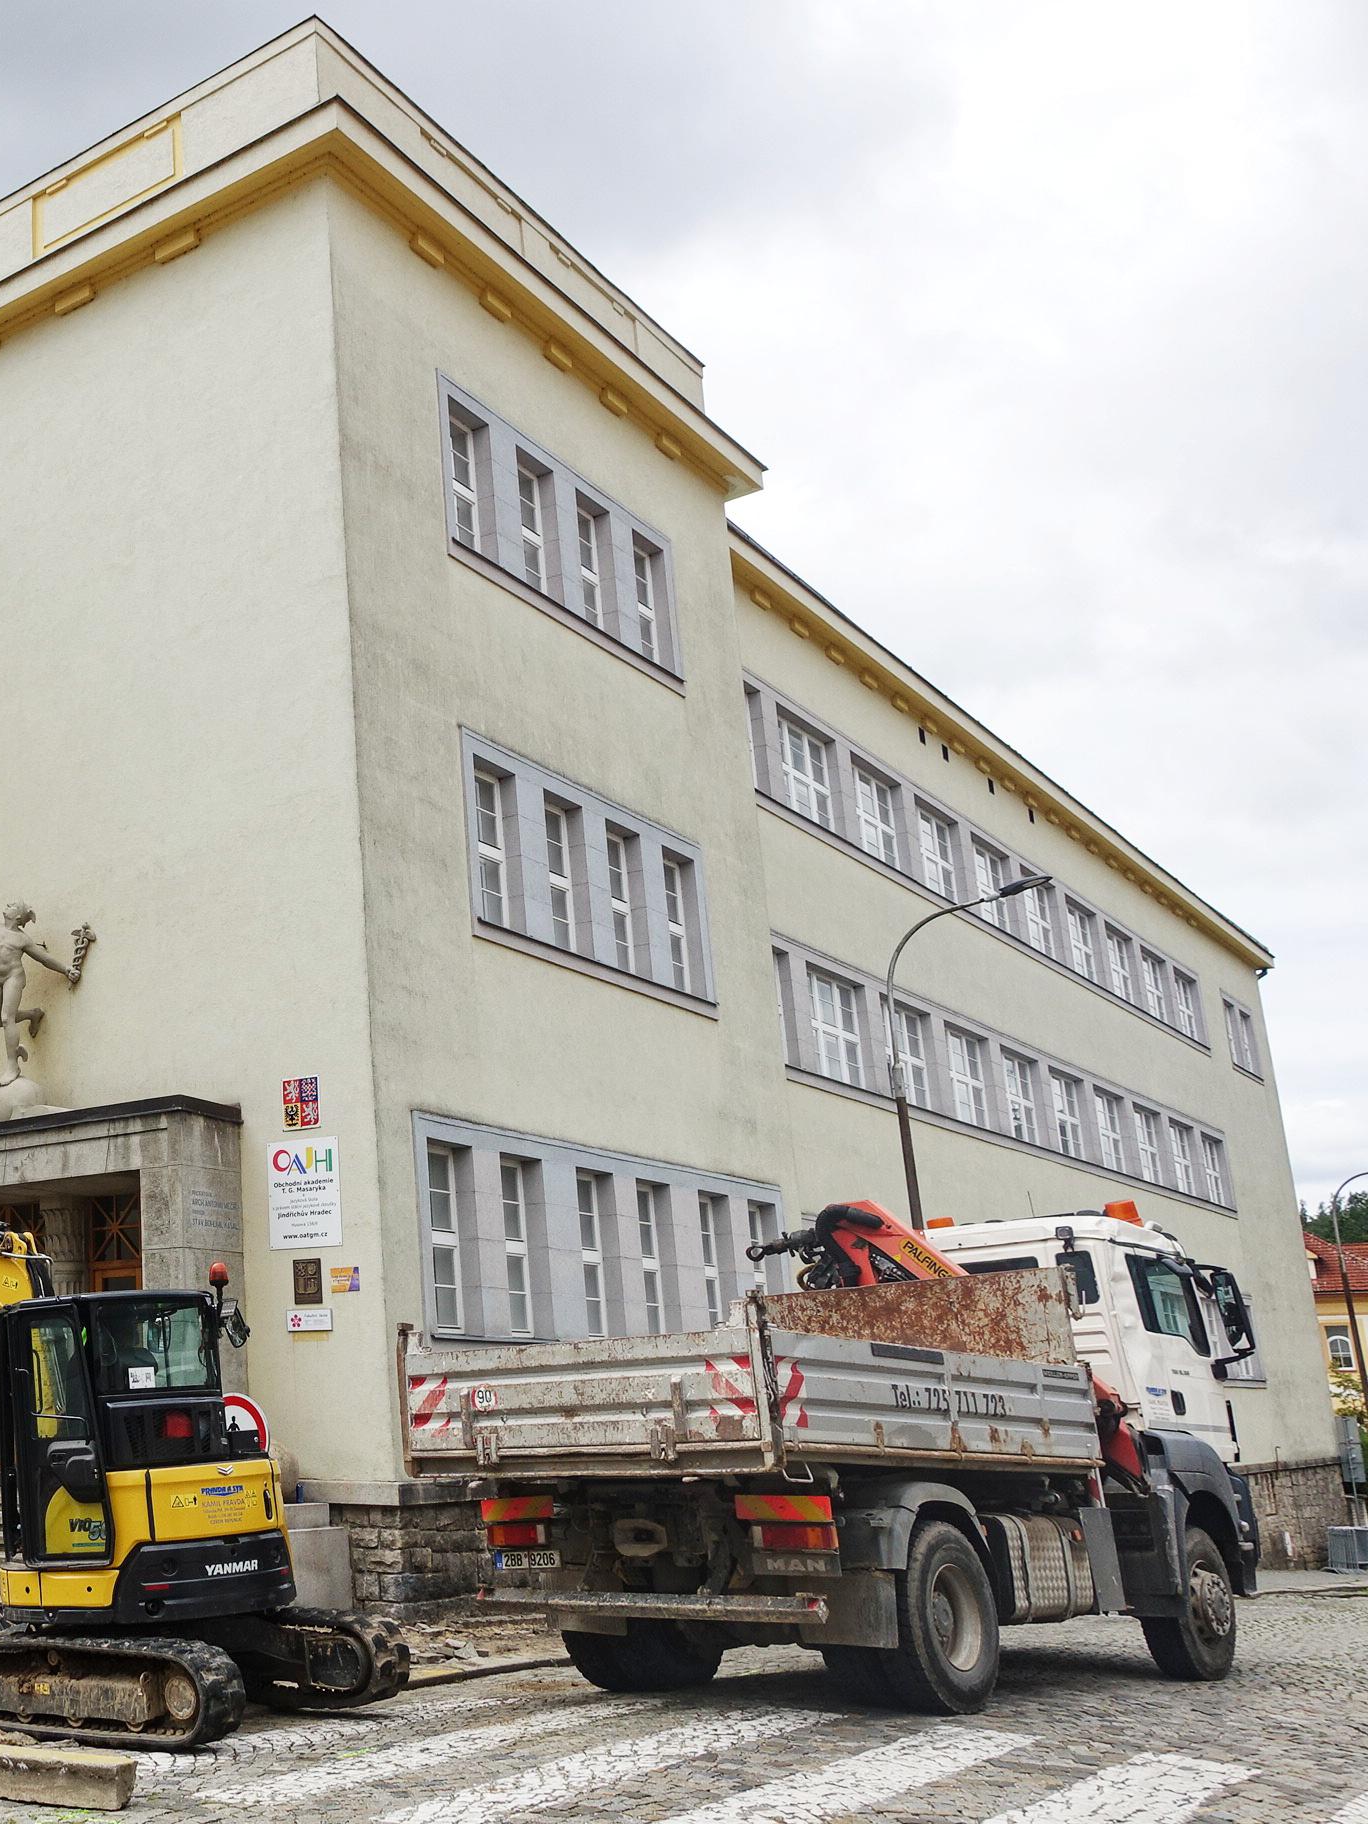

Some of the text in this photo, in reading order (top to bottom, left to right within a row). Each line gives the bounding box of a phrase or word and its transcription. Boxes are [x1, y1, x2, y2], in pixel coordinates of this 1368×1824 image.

[273, 1177, 334, 1189] Obchodní akademie
[297, 1184, 326, 1193] Masaryka
[277, 1210, 308, 1220] Jindřichův
[283, 1232, 328, 1240] www.oatgm.cz
[902, 1240, 953, 1278] PALFING
[477, 1389, 492, 1404] 90
[891, 1383, 1007, 1418] Tel.: 725 711 723
[504, 1552, 556, 1567] 2BB 9206
[766, 1558, 826, 1572] MAN
[205, 1559, 258, 1576] YANMAR
